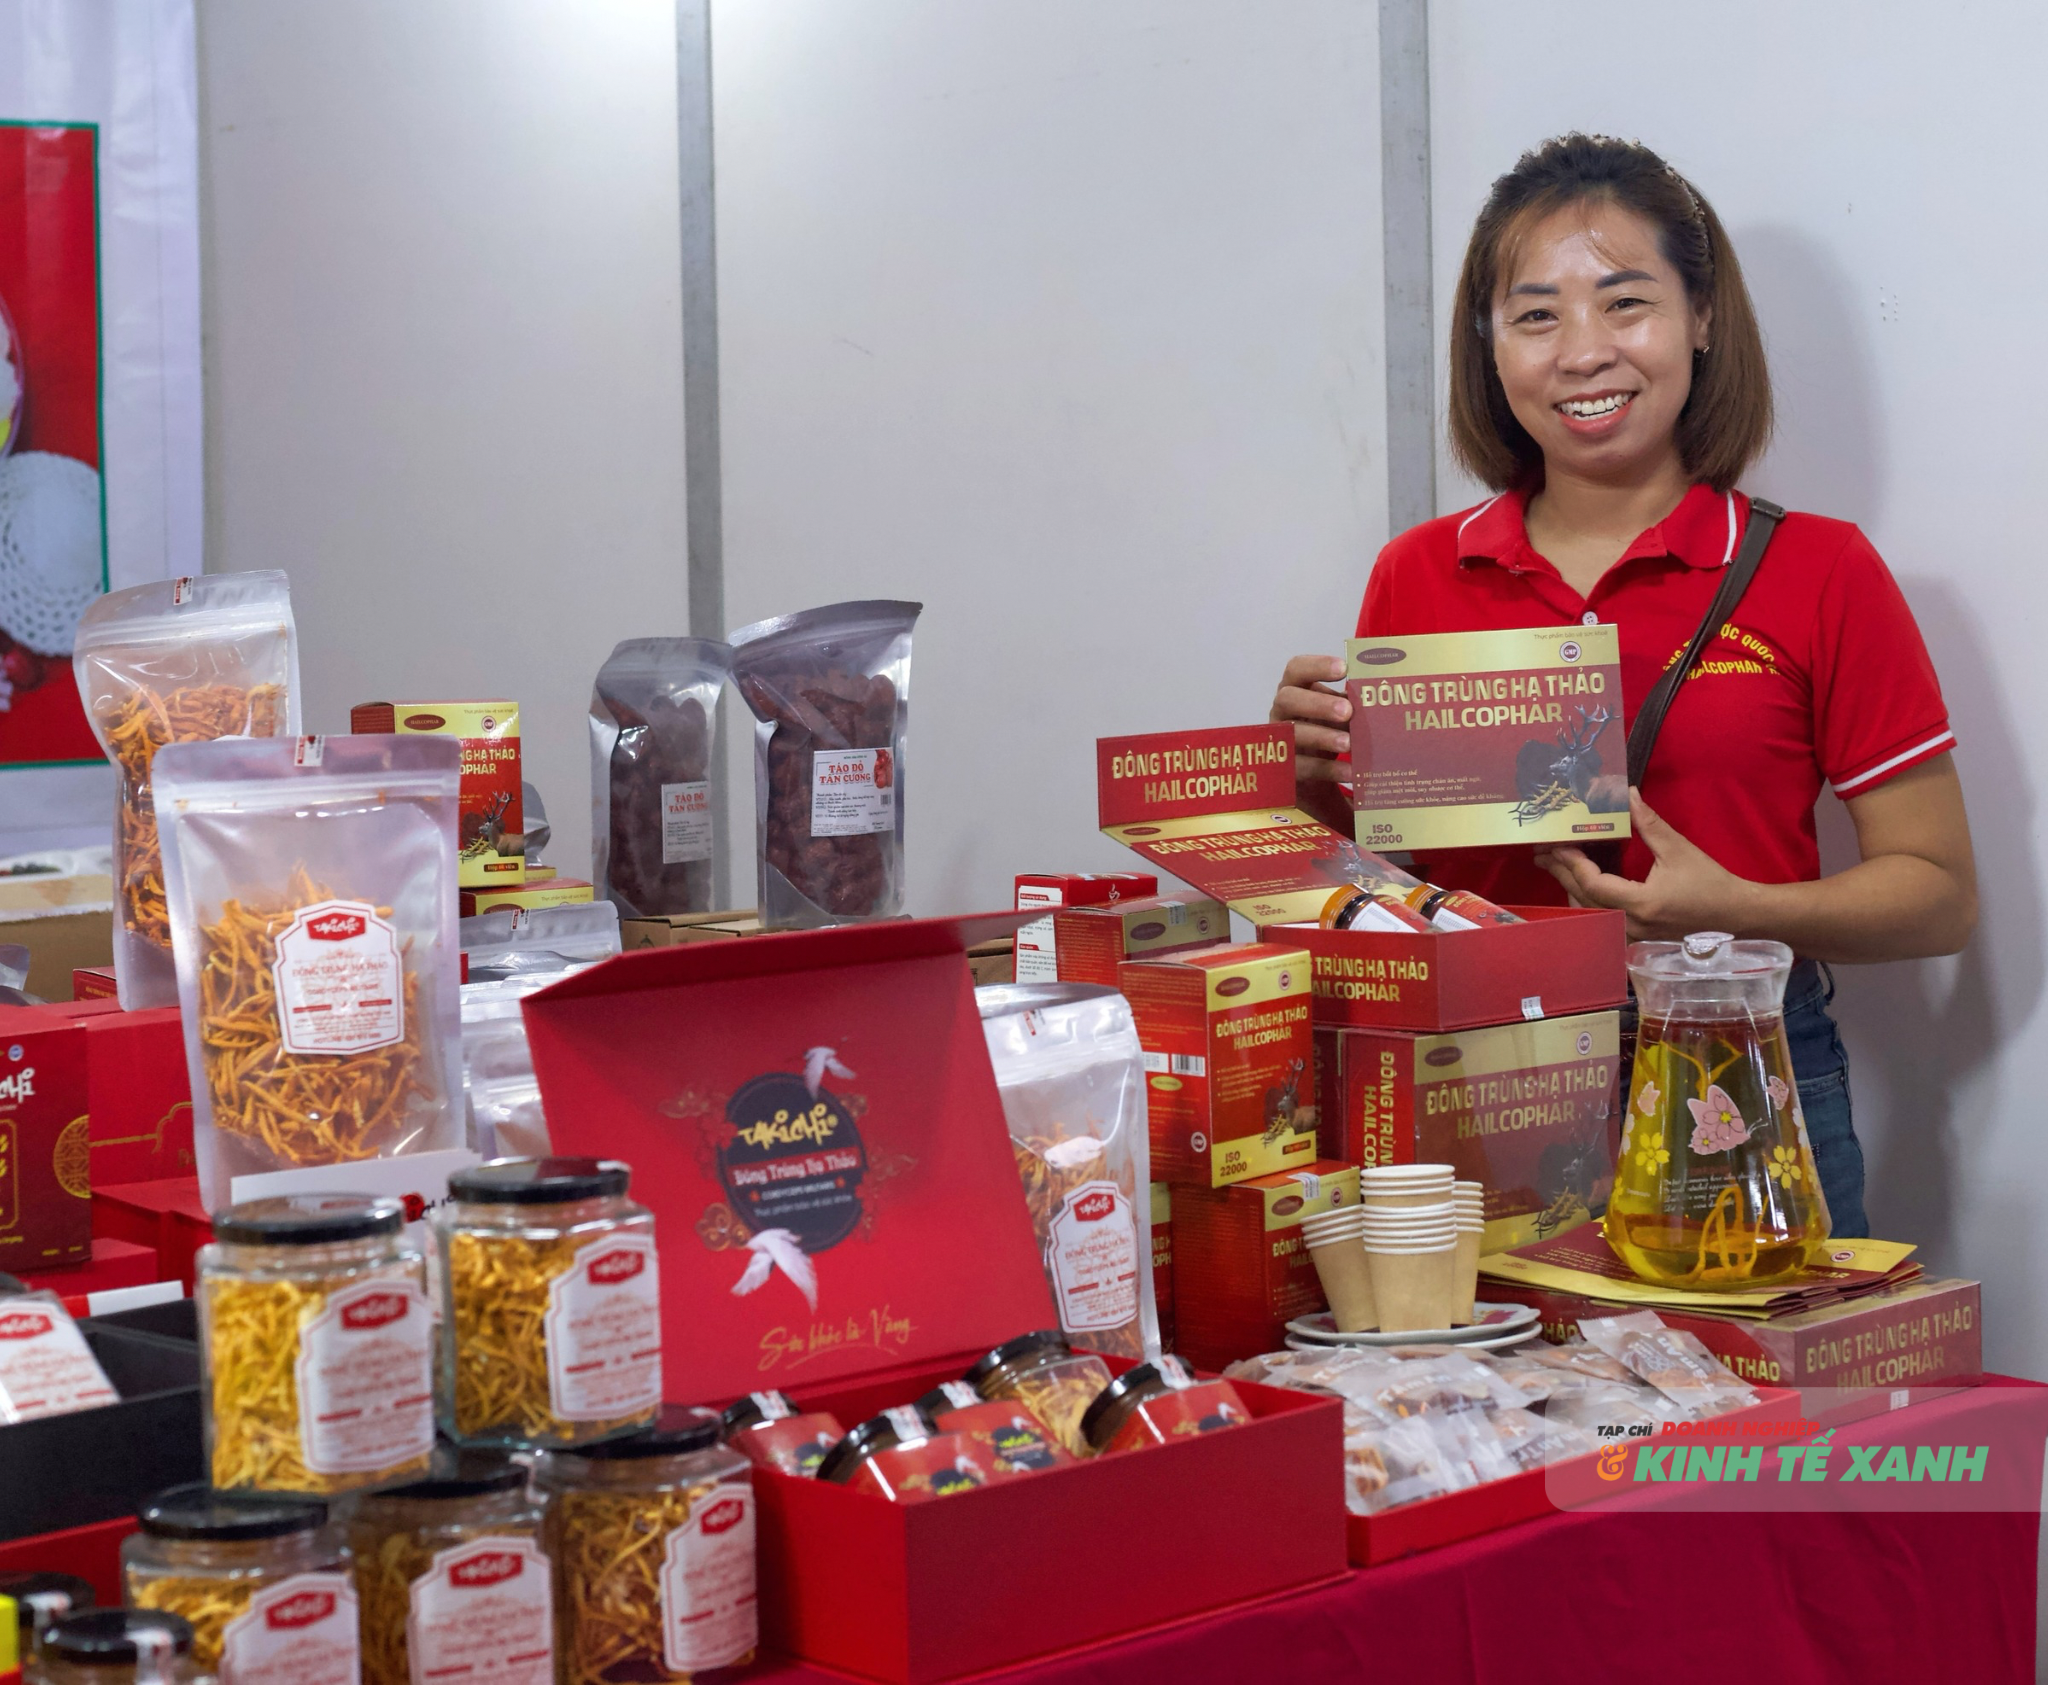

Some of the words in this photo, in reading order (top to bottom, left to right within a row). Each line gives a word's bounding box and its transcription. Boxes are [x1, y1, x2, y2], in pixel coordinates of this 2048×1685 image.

[1360, 679, 1426, 707] ĐÔNG
[1430, 675, 1508, 703] TRÙNG
[1511, 676, 1542, 701] HẠ
[1544, 666, 1605, 696] THẢO
[1405, 702, 1563, 731] HAILCOPHAR
[474, 749, 486, 762] HẠ
[489, 744, 516, 760] THẢO
[1112, 750, 1161, 779] ĐÔNG
[1163, 744, 1219, 774] TRÙNG
[1222, 744, 1242, 771] HẠ
[1245, 734, 1288, 766] THẢO
[460, 763, 496, 775] OPHAR
[1144, 771, 1258, 804] HAILCOPHAR
[1148, 838, 1205, 855] ĐÔNG
[1198, 832, 1265, 850] TRÙNG
[1282, 822, 1332, 840] THẢO
[1366, 834, 1403, 845] 22000
[1372, 824, 1393, 834] ISO
[1198, 840, 1321, 862] HAILCOPHAR
[1314, 954, 1364, 978] TRÙNG
[1366, 959, 1386, 982] HẠ
[1388, 955, 1428, 980] THẢO
[1312, 980, 1400, 1002] AILCOPHAR
[1216, 1018, 1242, 1038] ĐÔNG
[1243, 1012, 1272, 1032] TRÙNG
[1272, 1010, 1284, 1029] HẠ
[1284, 1003, 1308, 1022] THẢO
[1234, 1026, 1292, 1050] HAILCOPHAR
[1380, 1051, 1397, 1108] ĐÔNG
[1426, 1082, 1474, 1116] ĐÔNG
[1478, 1074, 1538, 1103] TRÙNG
[1538, 1070, 1559, 1100] HẠ
[1564, 1059, 1608, 1095] THẢO
[1457, 1100, 1576, 1140] HAILCOPHAR
[1380, 1112, 1396, 1166] TRÙN
[1220, 1160, 1247, 1178] 22000
[1226, 1150, 1240, 1163] ISO
[1806, 1337, 1852, 1374] ĐÔNG
[1856, 1323, 1907, 1360] TRÙNG
[1910, 1317, 1930, 1346] HẠ
[1933, 1302, 1972, 1339] THẢO
[1735, 1354, 1780, 1382] THẢO
[1836, 1346, 1945, 1396] HAILCOPHAR
